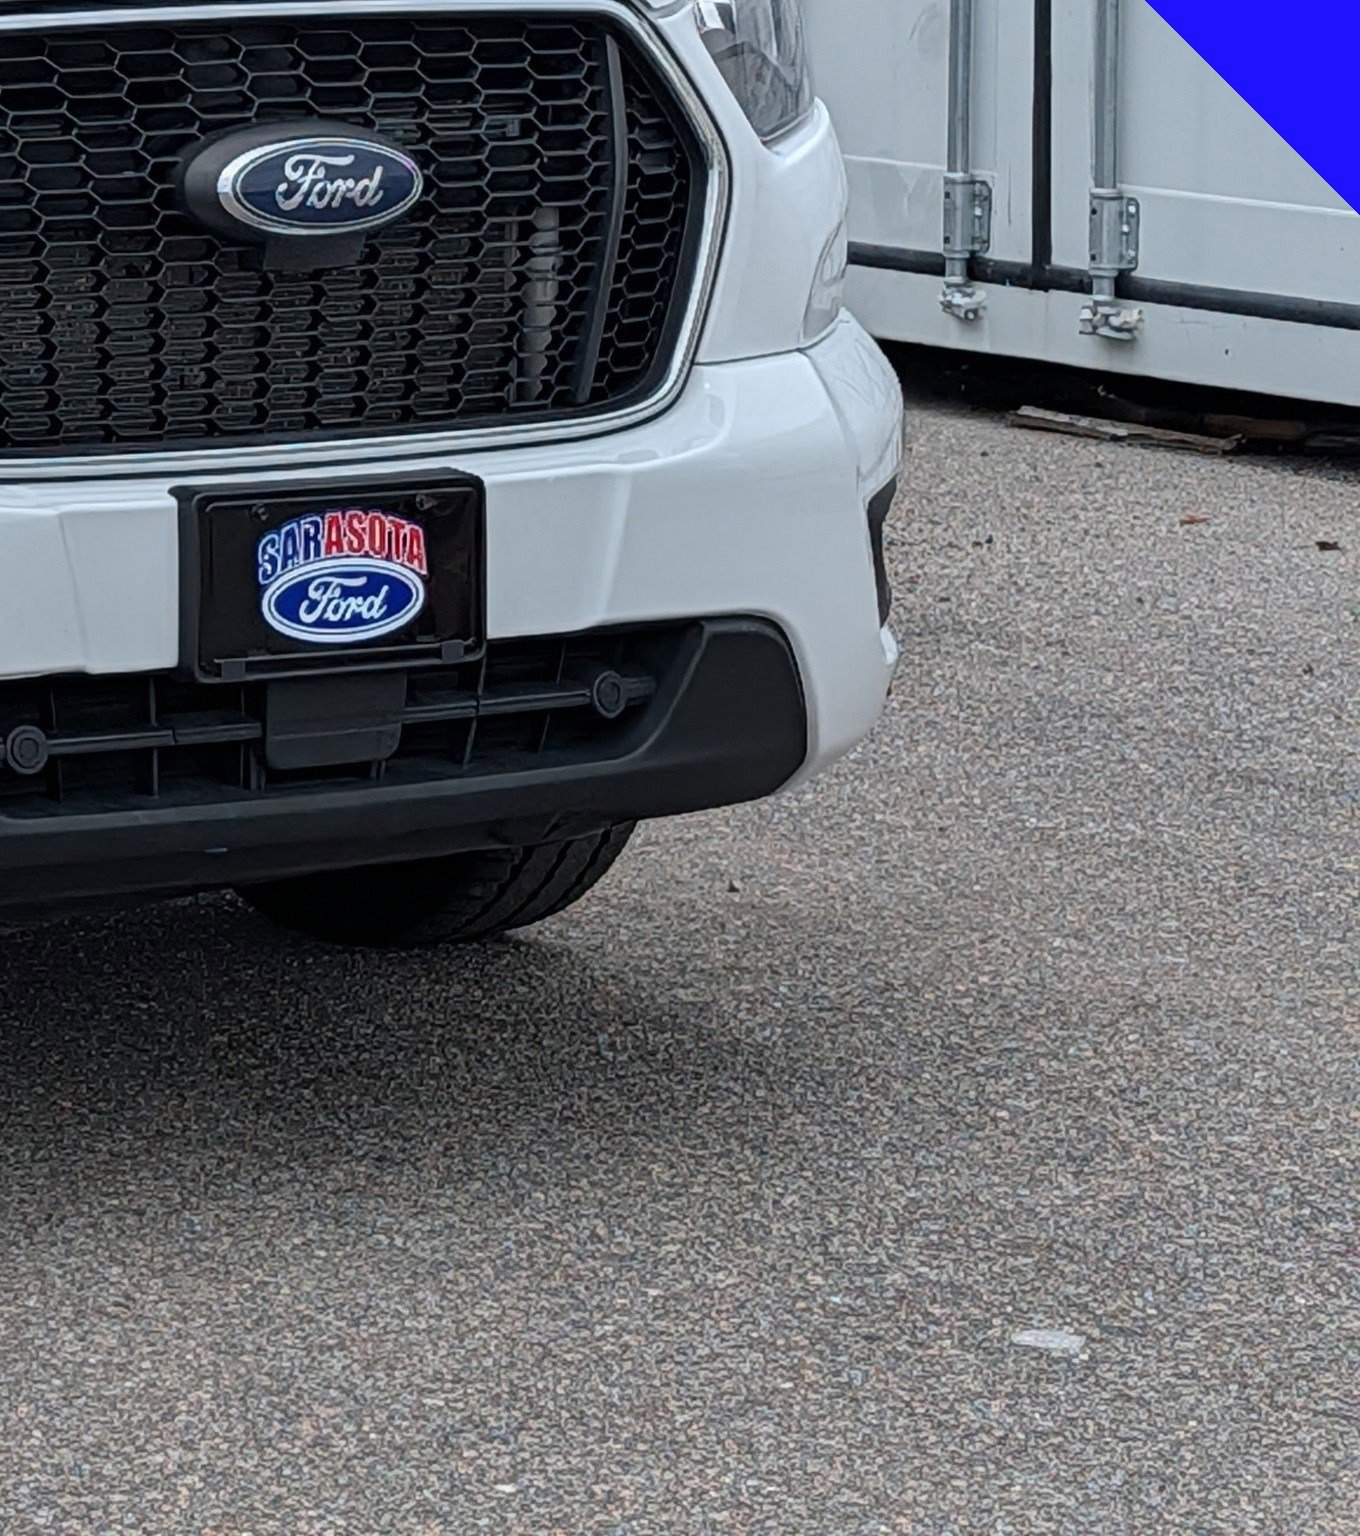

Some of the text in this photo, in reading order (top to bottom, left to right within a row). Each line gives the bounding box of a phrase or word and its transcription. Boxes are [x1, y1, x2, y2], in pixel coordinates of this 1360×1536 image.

[275, 153, 384, 212] Ford
[257, 508, 429, 586] SARASOTA
[298, 575, 389, 623] Ford
